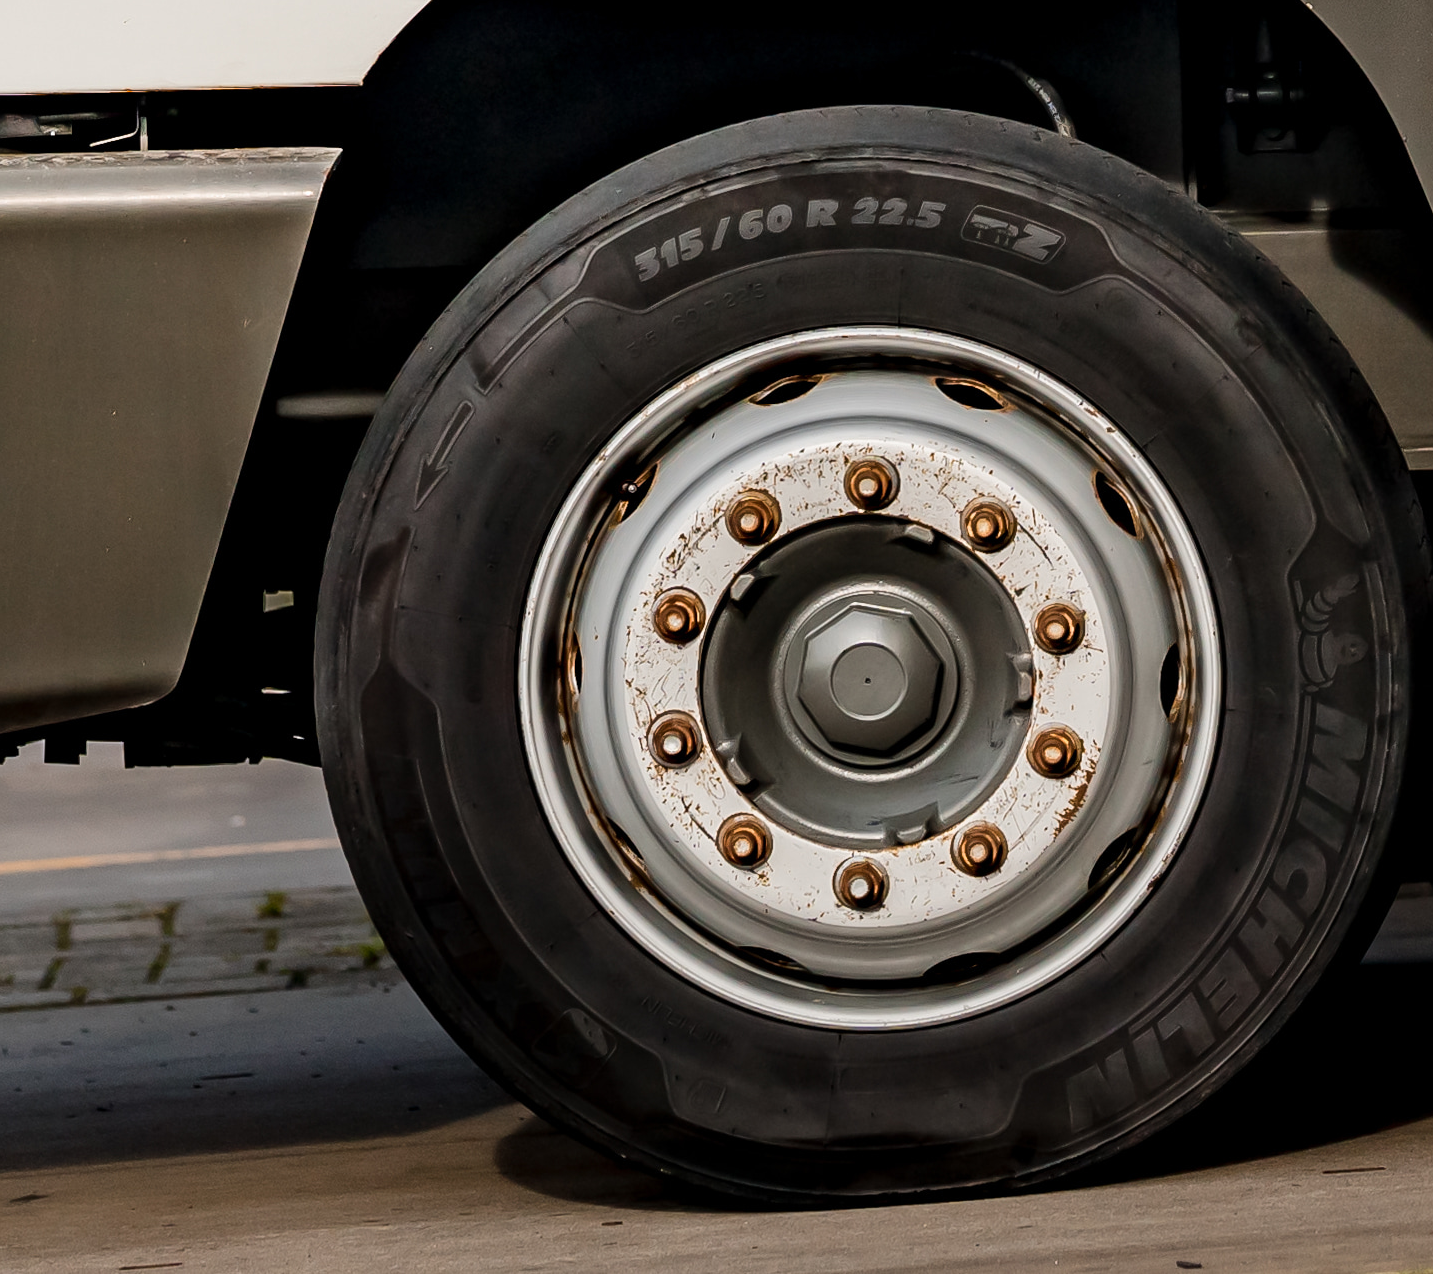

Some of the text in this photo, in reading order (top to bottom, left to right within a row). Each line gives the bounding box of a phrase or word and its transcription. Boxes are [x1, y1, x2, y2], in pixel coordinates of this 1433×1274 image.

[805, 198, 841, 229] R
[850, 196, 948, 230] 22.5
[1068, 701, 1369, 1131] MICHELIN
